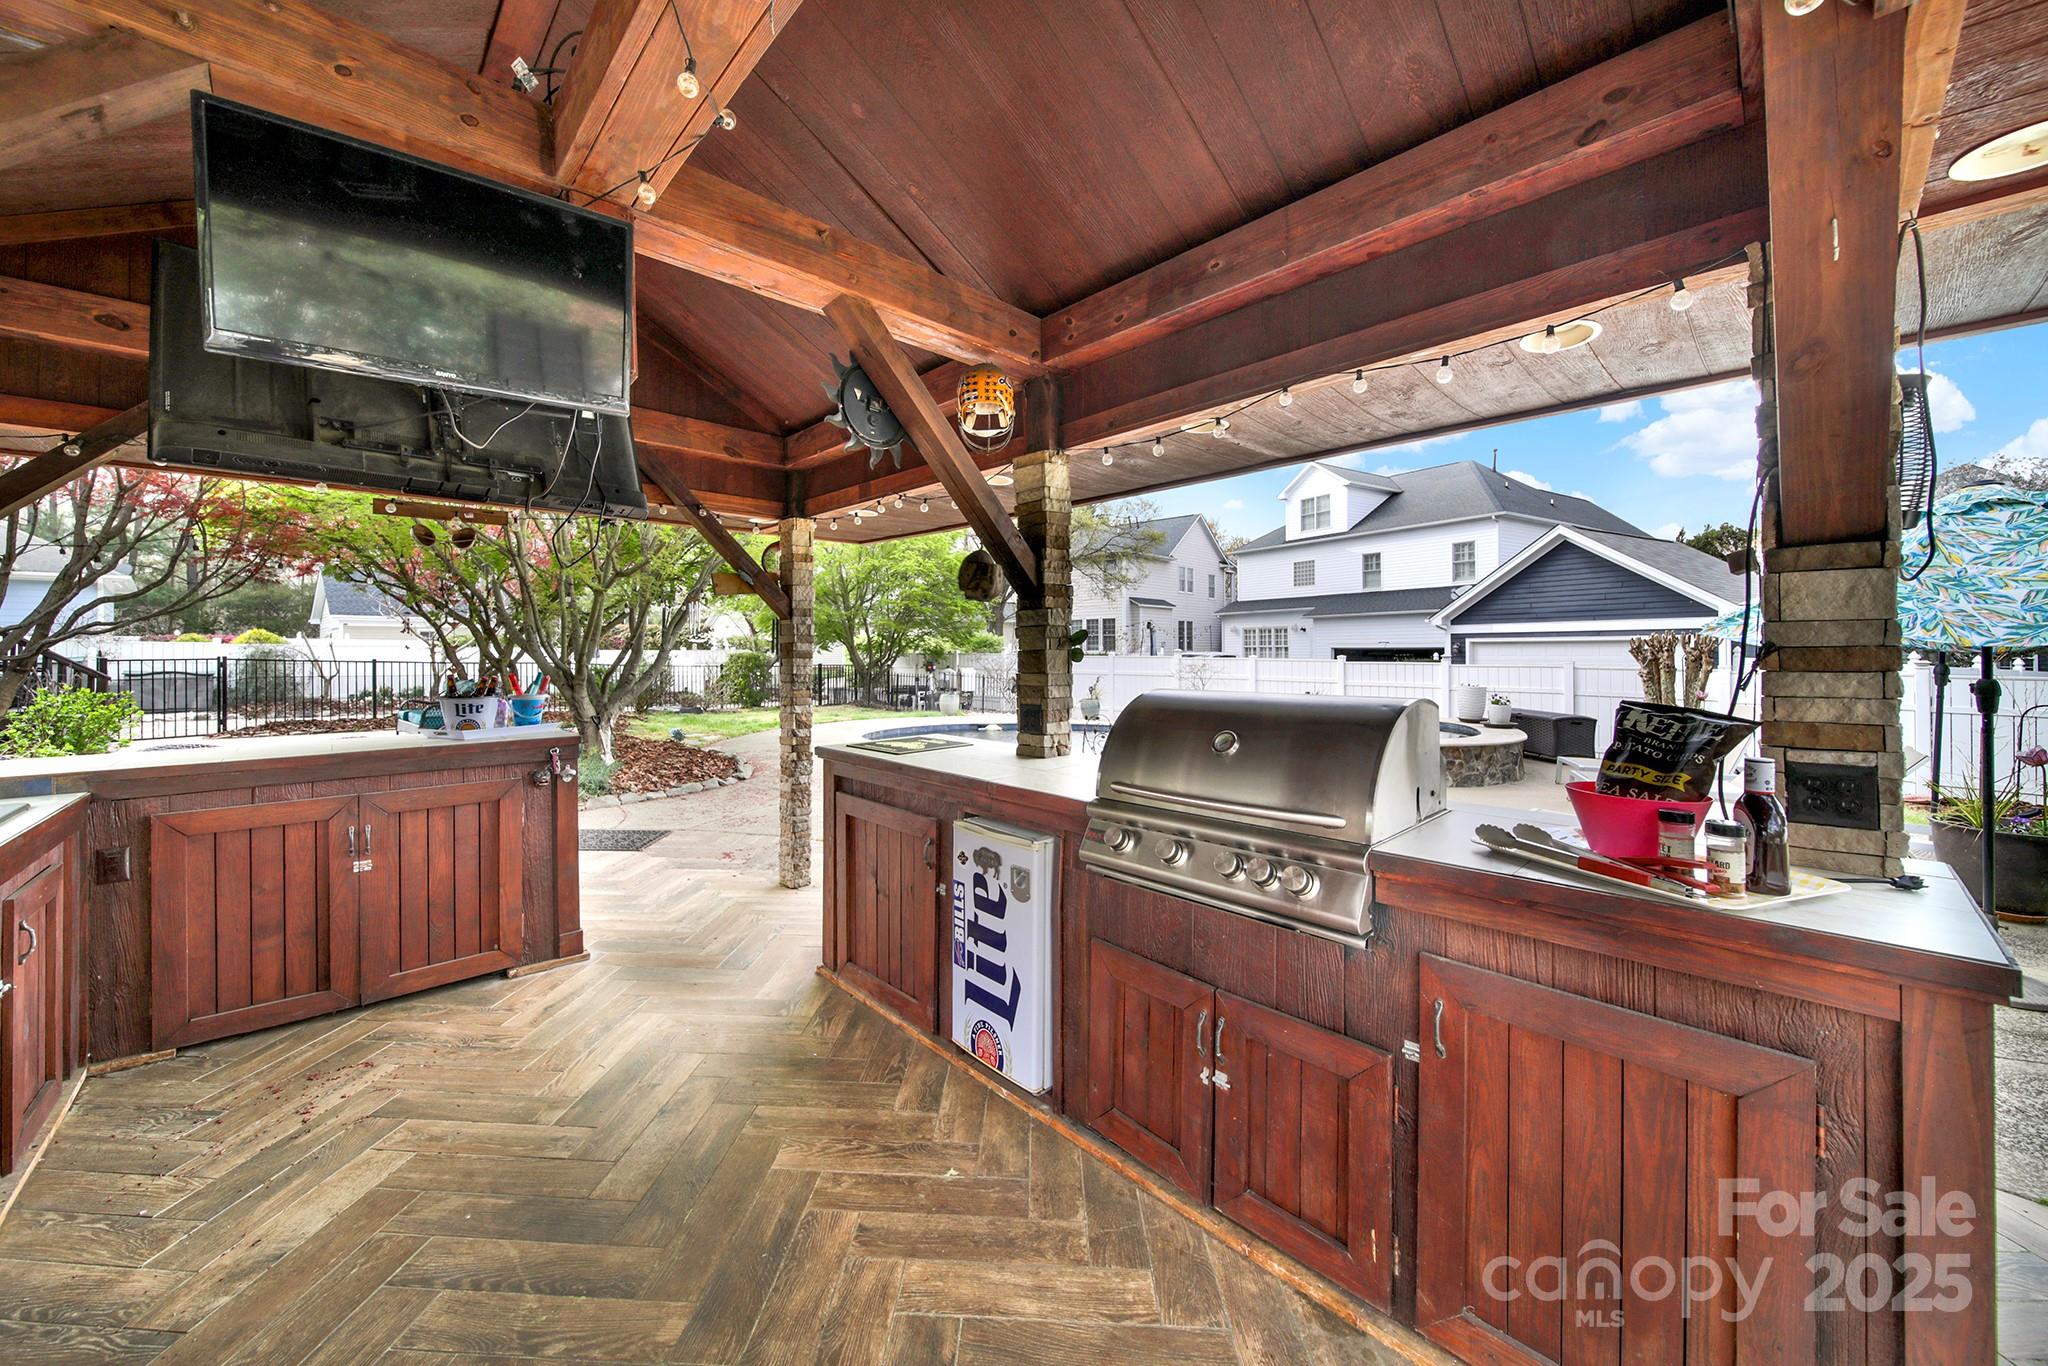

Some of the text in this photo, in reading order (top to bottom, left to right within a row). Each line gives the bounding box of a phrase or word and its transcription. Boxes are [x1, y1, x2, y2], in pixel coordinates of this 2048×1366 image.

[455, 703, 484, 717] Lite
[1612, 740, 1663, 759] POTATO
[1606, 763, 1682, 785] PARTY SIZE
[1597, 782, 1621, 796] EA
[953, 882, 965, 943] BILLS
[965, 872, 1021, 1032] Lite
